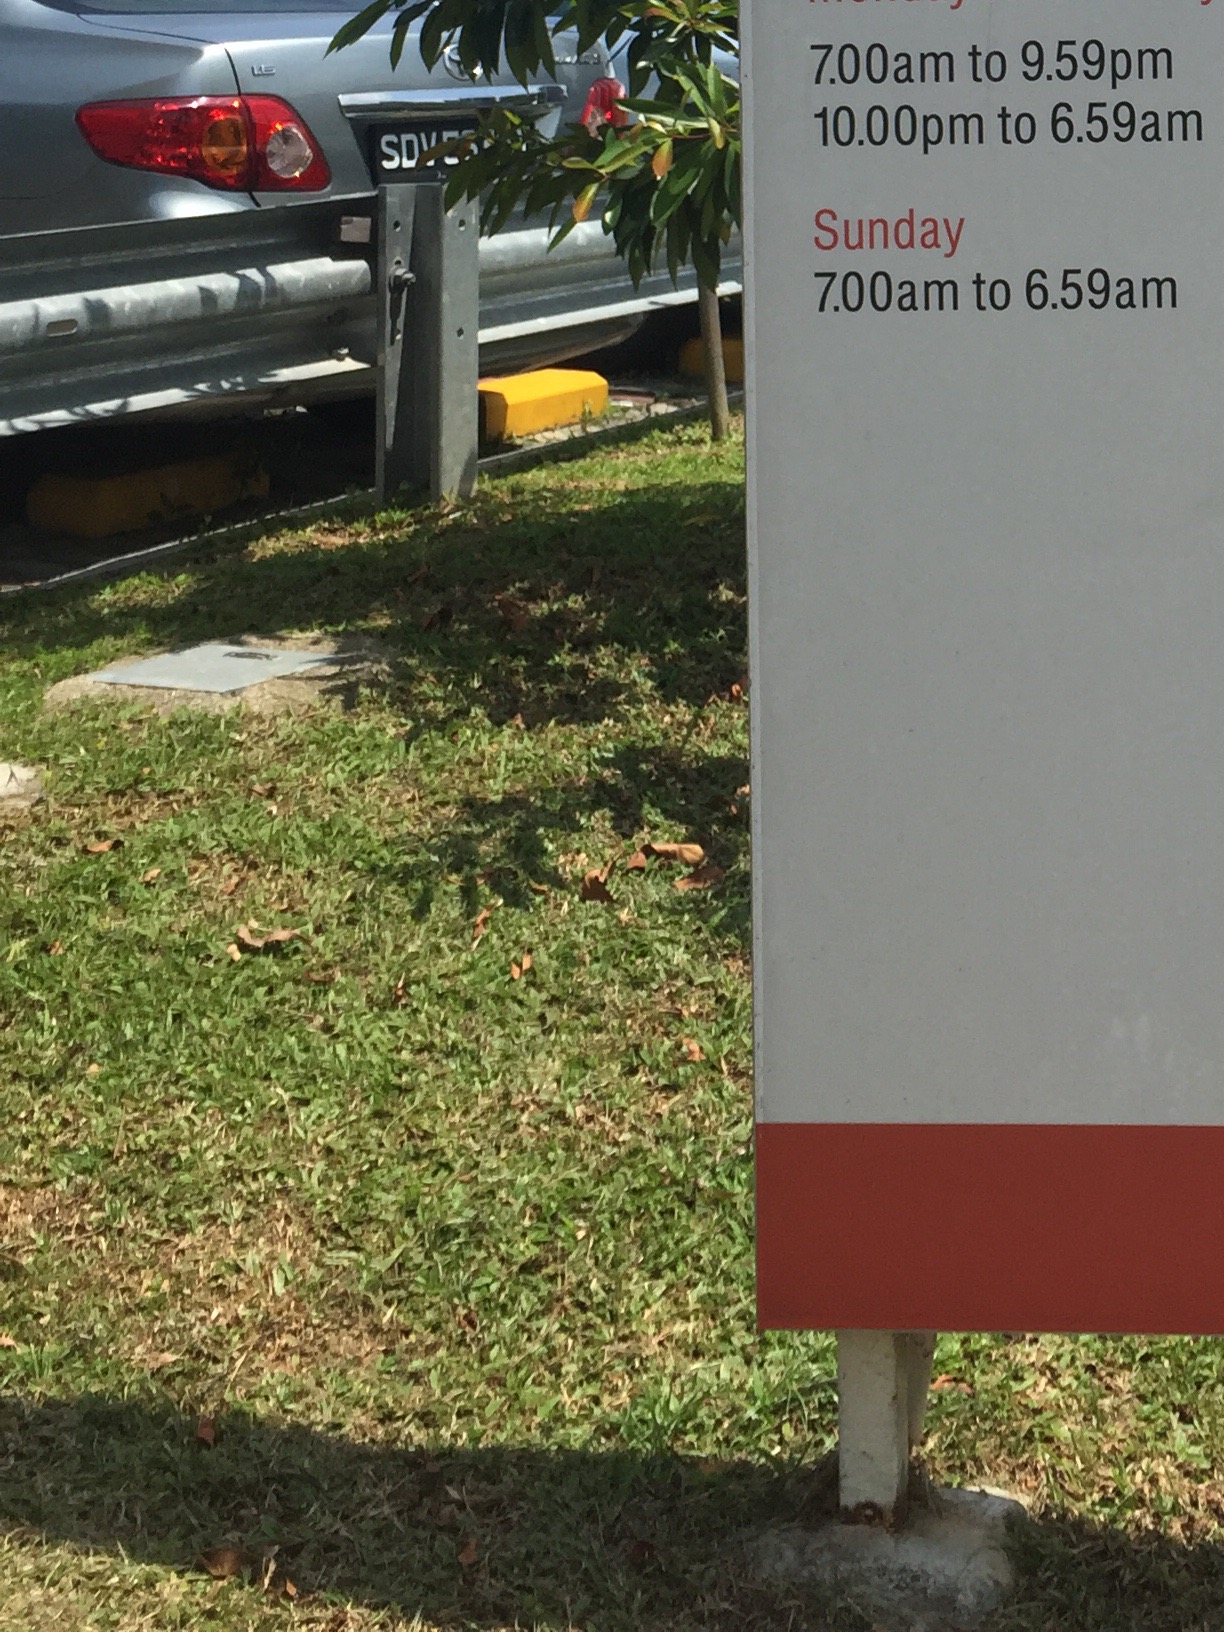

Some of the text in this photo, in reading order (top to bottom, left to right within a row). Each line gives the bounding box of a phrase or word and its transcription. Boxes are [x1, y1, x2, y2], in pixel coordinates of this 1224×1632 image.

[810, 39, 1174, 90] 7.00am to 9.59pm
[813, 100, 1203, 155] 10.00pm to 6.59am
[813, 208, 965, 258] Sunday
[813, 267, 1177, 313] 7.00am to 6.59am
